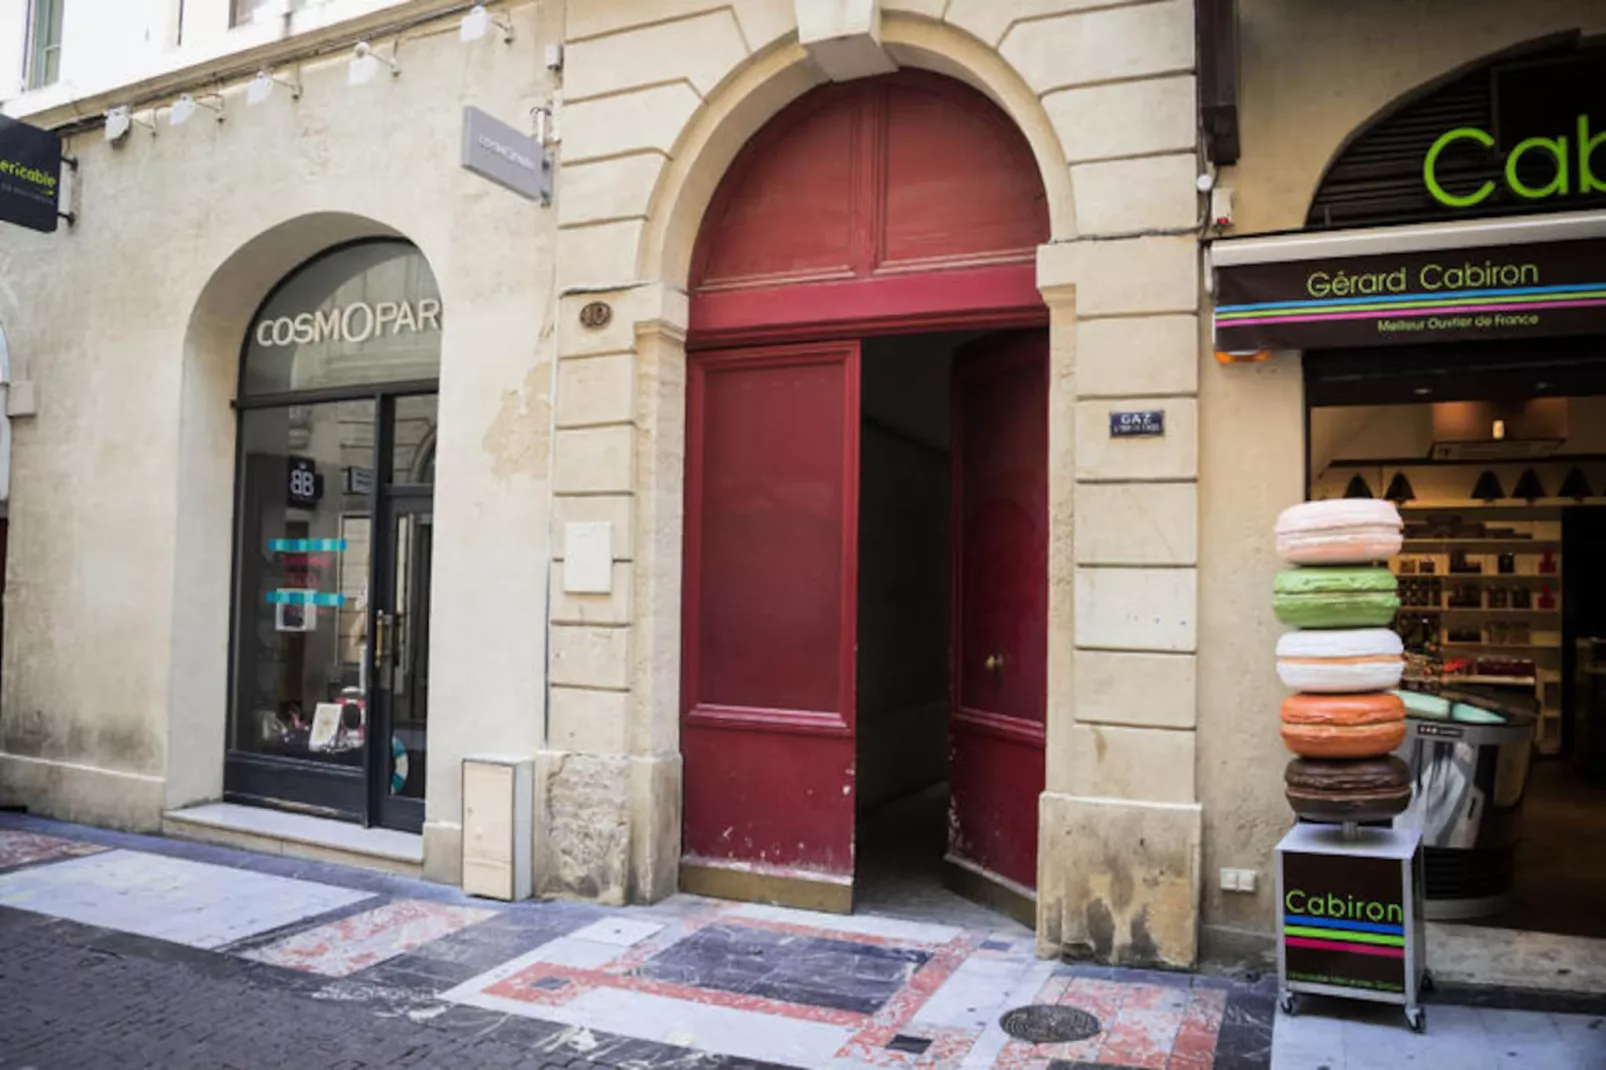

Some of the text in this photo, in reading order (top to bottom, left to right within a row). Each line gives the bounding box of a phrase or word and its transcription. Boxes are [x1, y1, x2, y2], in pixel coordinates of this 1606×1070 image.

[1306, 260, 1539, 298] Gérard Cabiron
[256, 299, 441, 347] COSMOPAR
[1494, 313, 1539, 327] France
[1285, 889, 1403, 922] Cabiron
